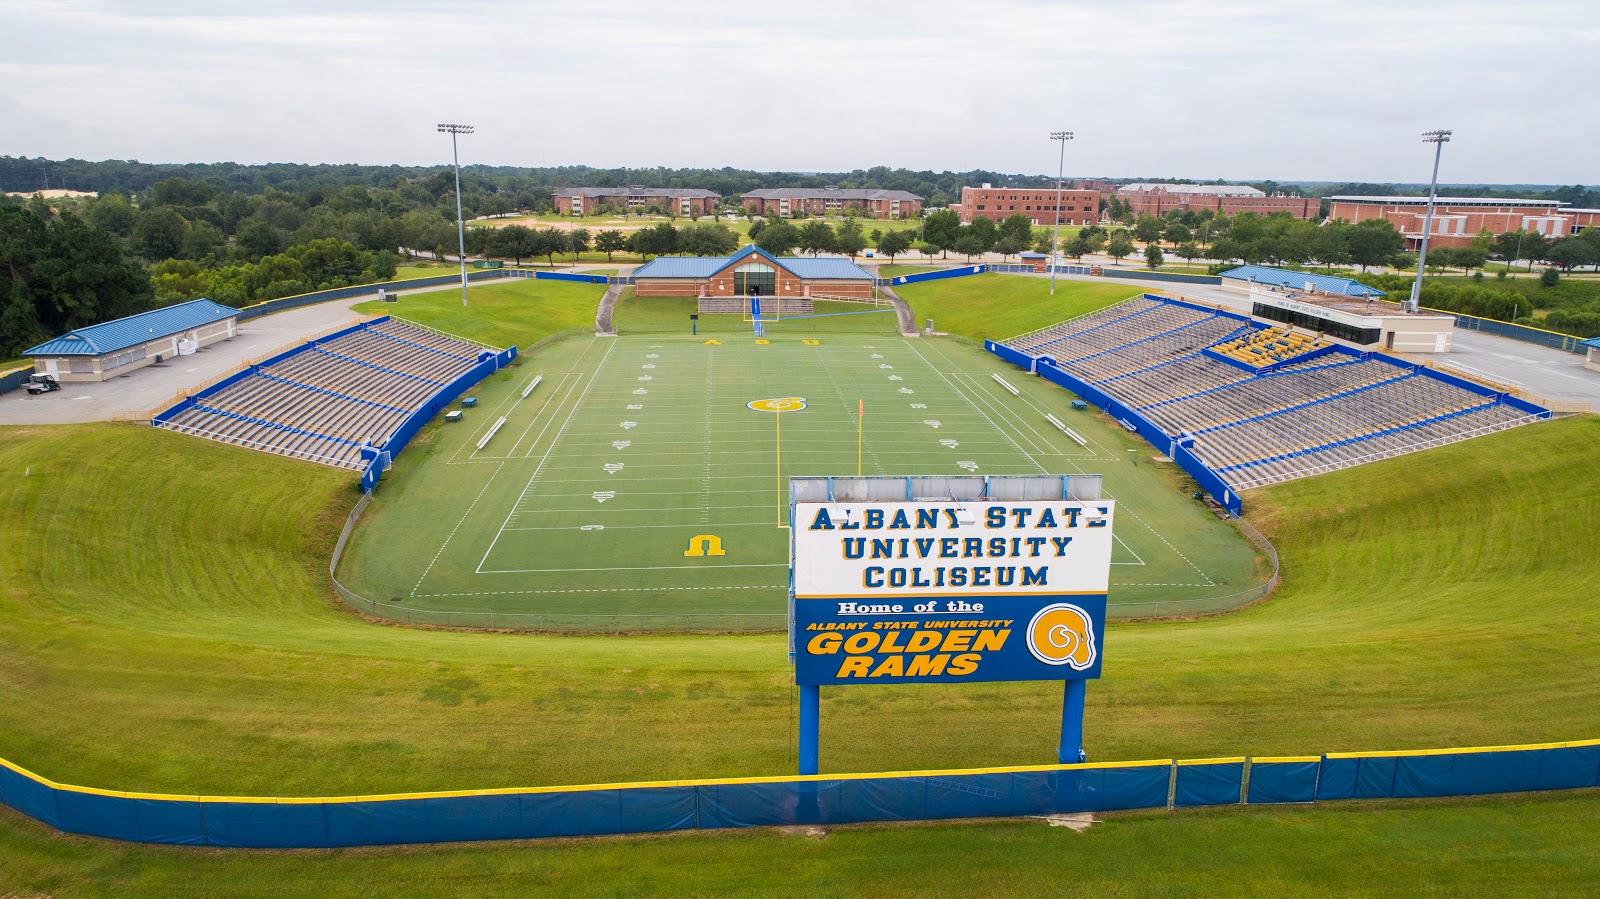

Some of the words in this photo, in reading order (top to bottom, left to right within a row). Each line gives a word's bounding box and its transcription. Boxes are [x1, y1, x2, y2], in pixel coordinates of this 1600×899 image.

[841, 537, 1073, 560] UNIVERSITY
[862, 566, 1049, 589] COLISEUM
[838, 602, 903, 614] Home
[914, 601, 938, 613] of
[947, 601, 984, 613] the
[806, 622, 868, 631] ALBANY
[872, 621, 919, 630] STATE
[924, 619, 1014, 629] UNIVERSITY
[806, 629, 1012, 655] GOLDEN
[835, 653, 982, 678] RAMS
